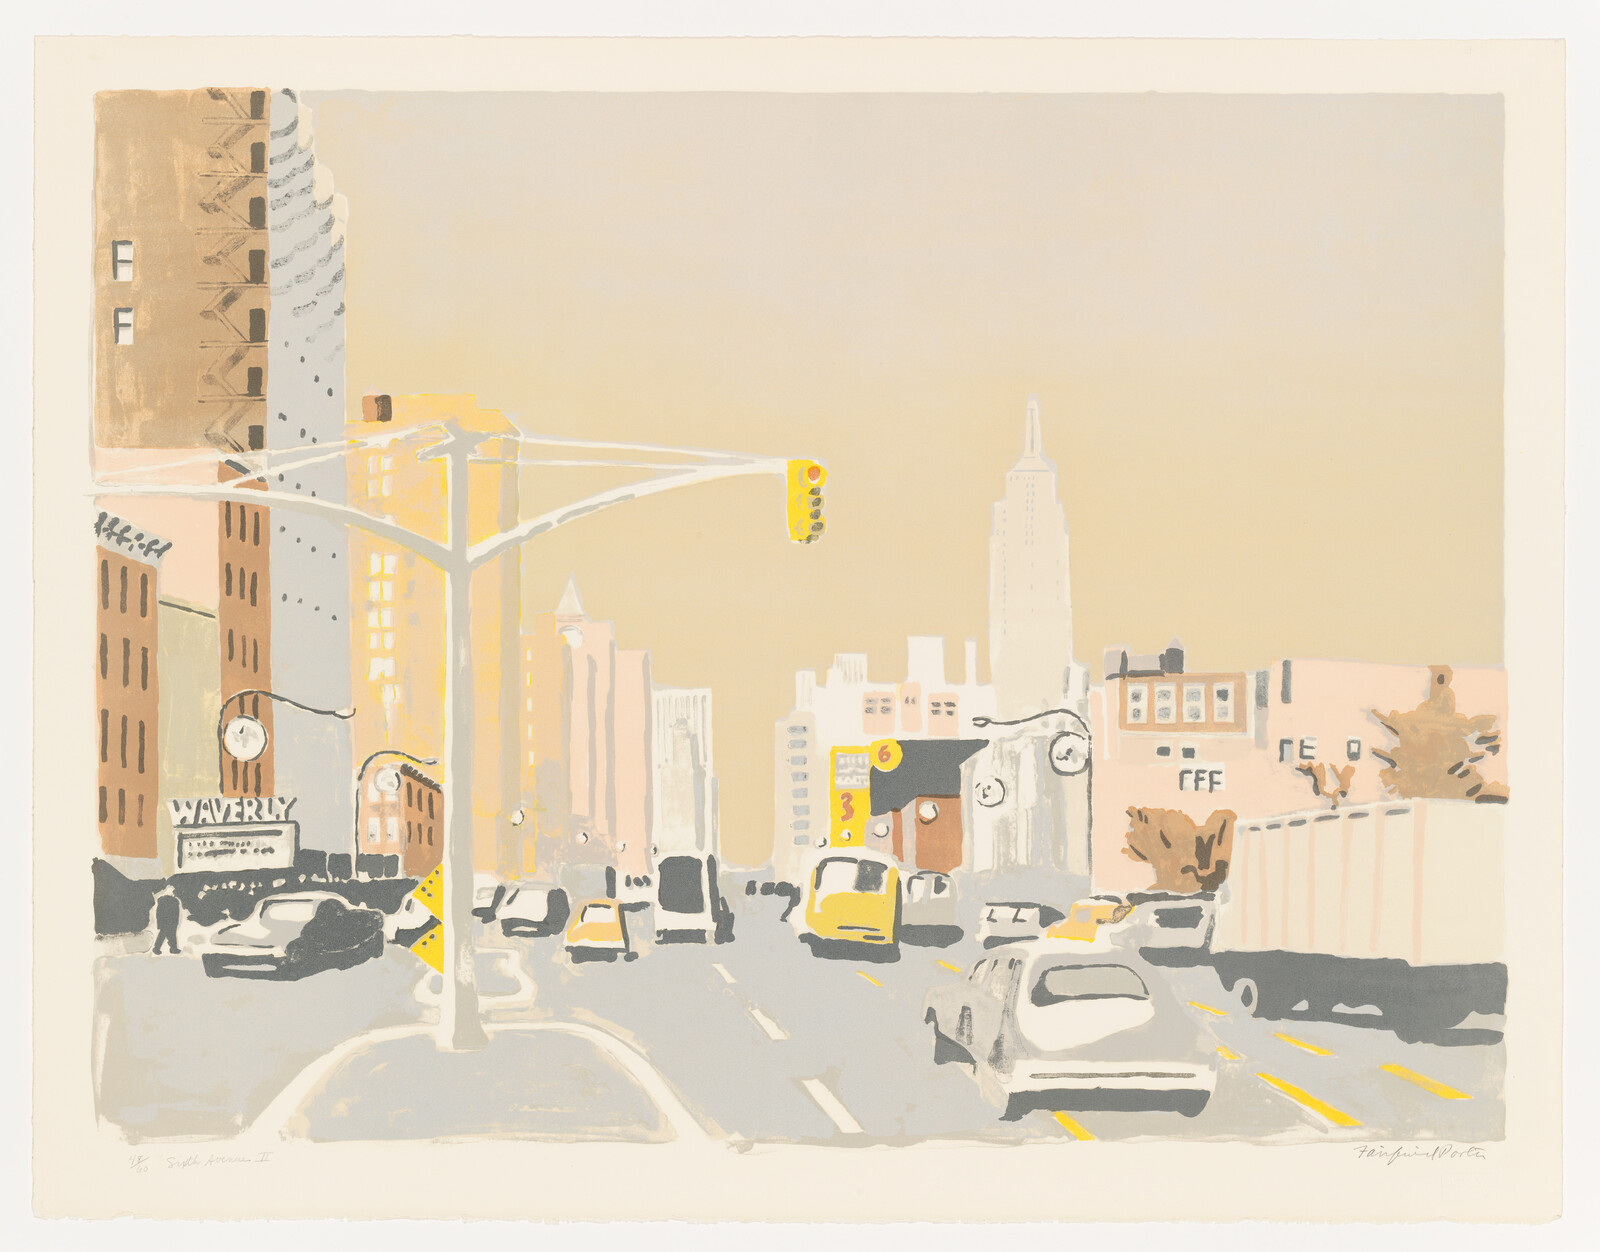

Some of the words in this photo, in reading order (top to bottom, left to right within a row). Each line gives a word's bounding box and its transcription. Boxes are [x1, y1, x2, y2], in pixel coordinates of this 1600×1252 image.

[877, 744, 891, 763] 6
[168, 797, 298, 824] WAVERLY
[840, 791, 854, 822] 3
